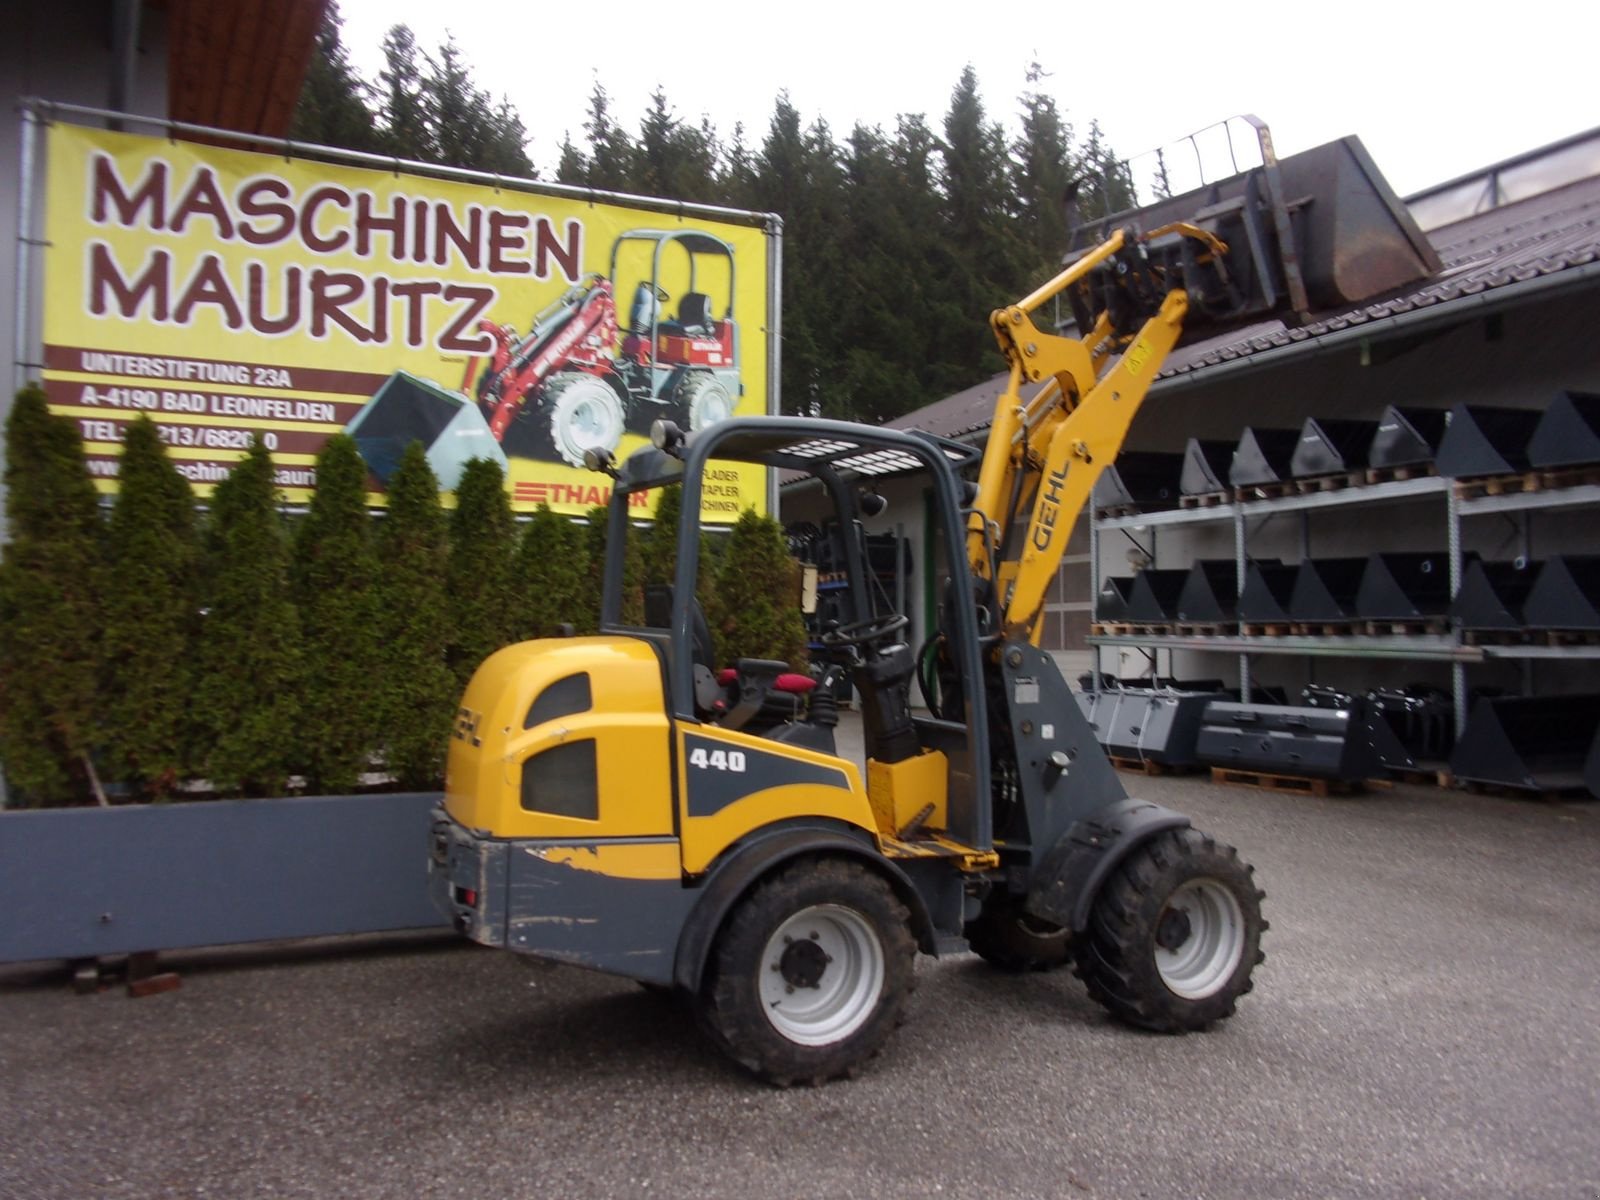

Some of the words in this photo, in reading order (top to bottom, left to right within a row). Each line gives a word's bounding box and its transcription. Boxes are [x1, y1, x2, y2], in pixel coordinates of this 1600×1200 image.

[91, 153, 582, 284] MASCHINEN
[91, 242, 494, 352] MAURITZ
[80, 351, 250, 385] UNTERSTIFTUNG
[254, 367, 293, 388] 23A
[80, 385, 158, 411] A-4190
[162, 391, 207, 413] BAD
[211, 395, 336, 422] LEONFELDEN
[1032, 459, 1071, 552] GEHL
[689, 747, 747, 773] 440
